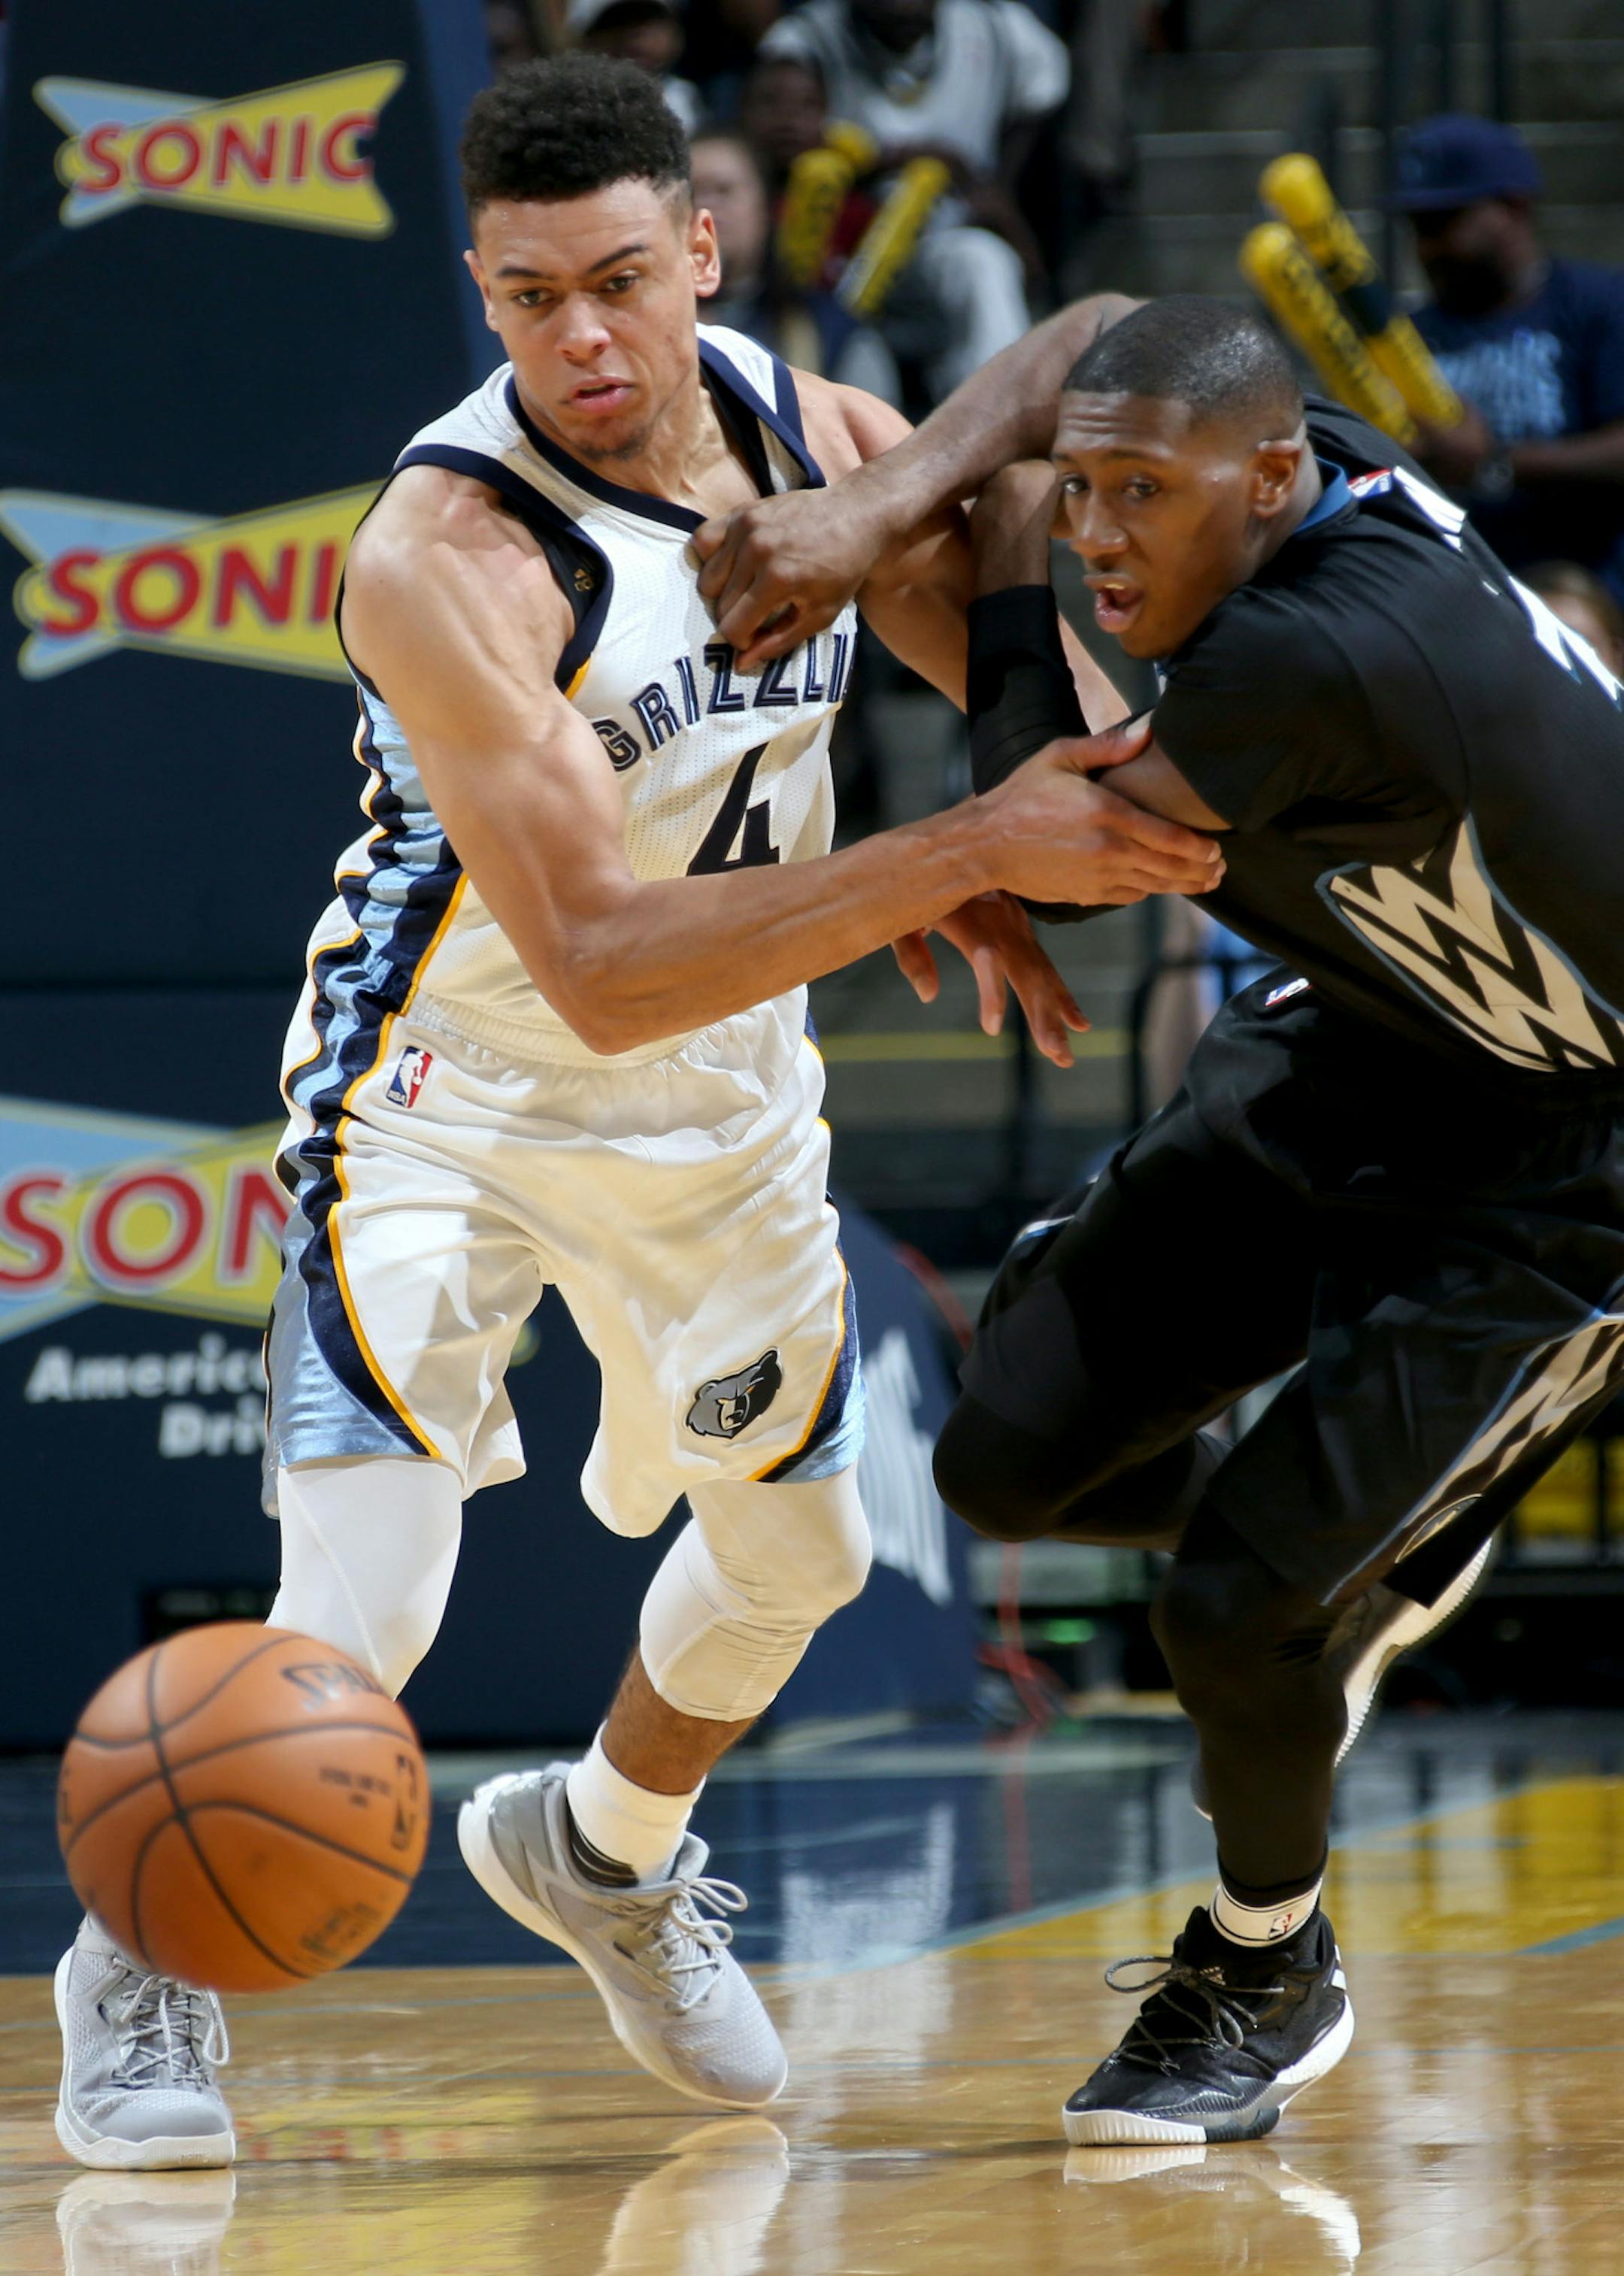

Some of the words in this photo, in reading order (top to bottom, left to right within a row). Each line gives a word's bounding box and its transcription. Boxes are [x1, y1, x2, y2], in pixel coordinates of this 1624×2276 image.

[78, 111, 377, 193] SONIC
[592, 633, 857, 772] GRIZZLI
[686, 741, 780, 877] 4
[159, 1395, 268, 1459] Dri
